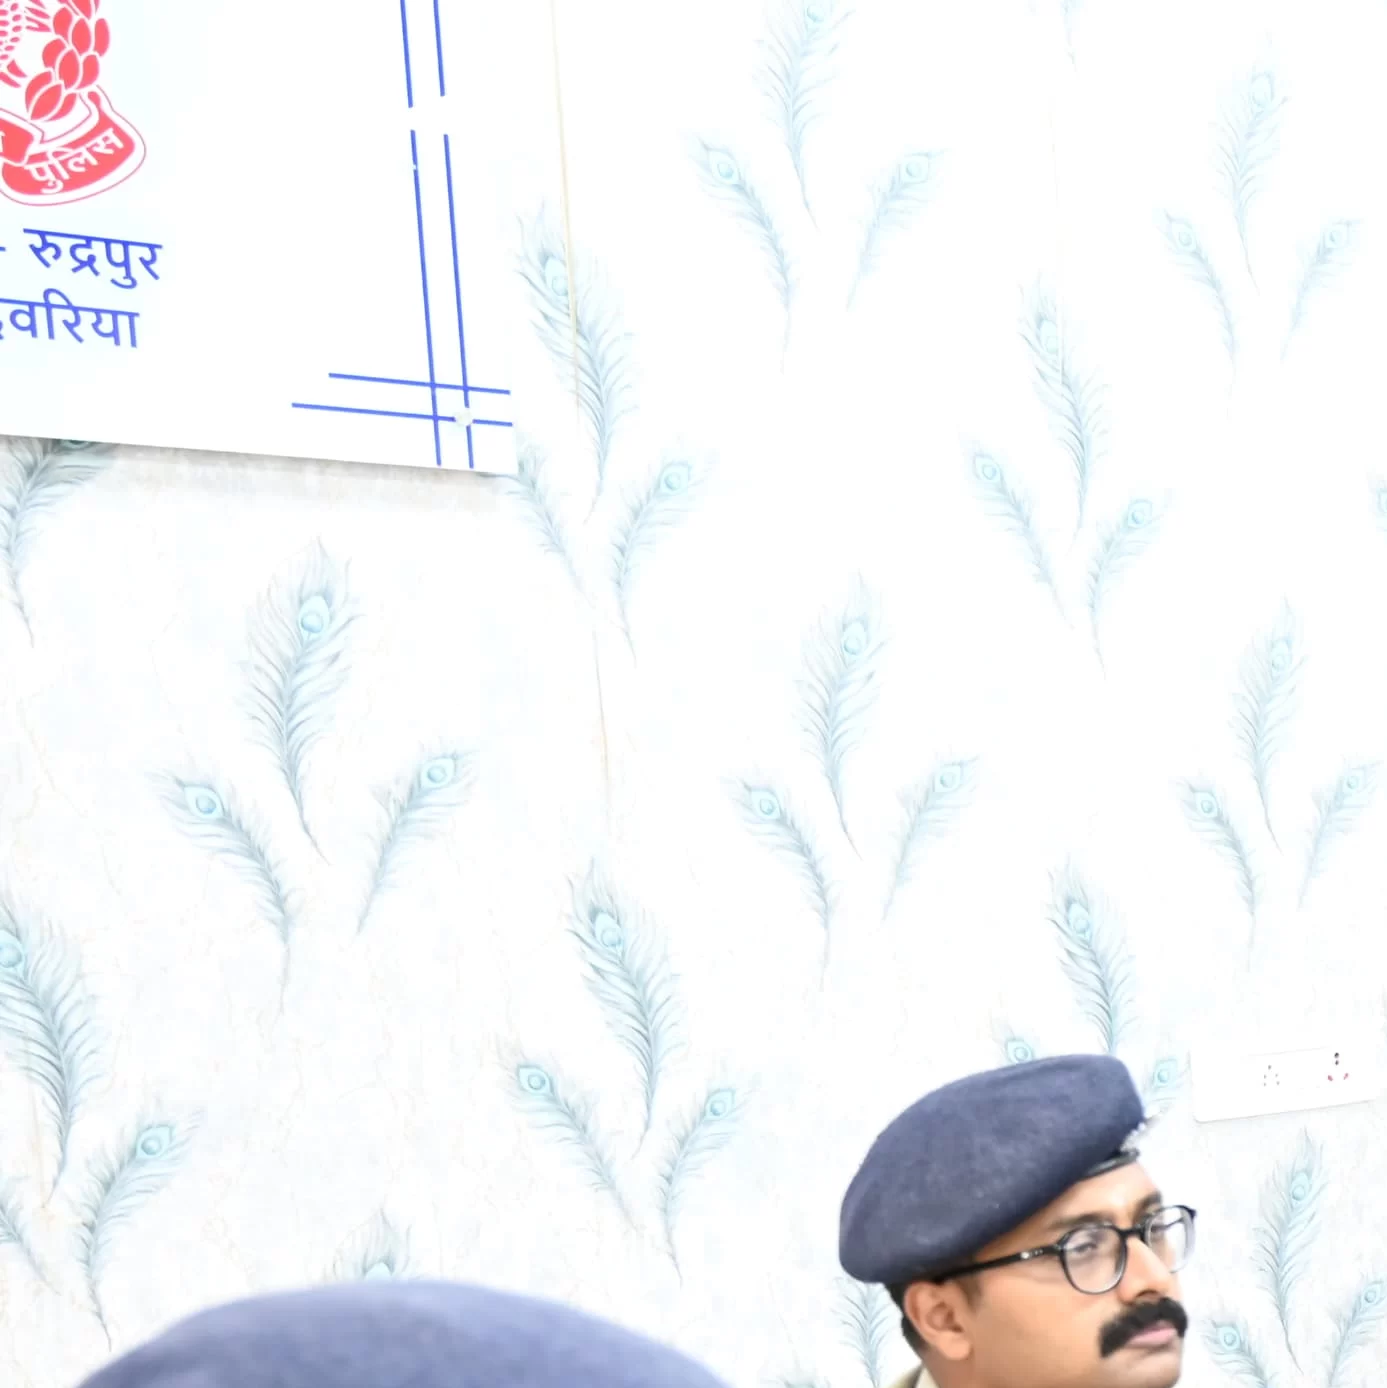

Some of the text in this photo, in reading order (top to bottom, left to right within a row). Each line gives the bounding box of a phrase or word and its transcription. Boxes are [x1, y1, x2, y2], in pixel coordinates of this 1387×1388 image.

[24, 127, 124, 193] पुलिस
[23, 228, 162, 289] रुद्रपुर
[0, 288, 139, 348] वरिया
